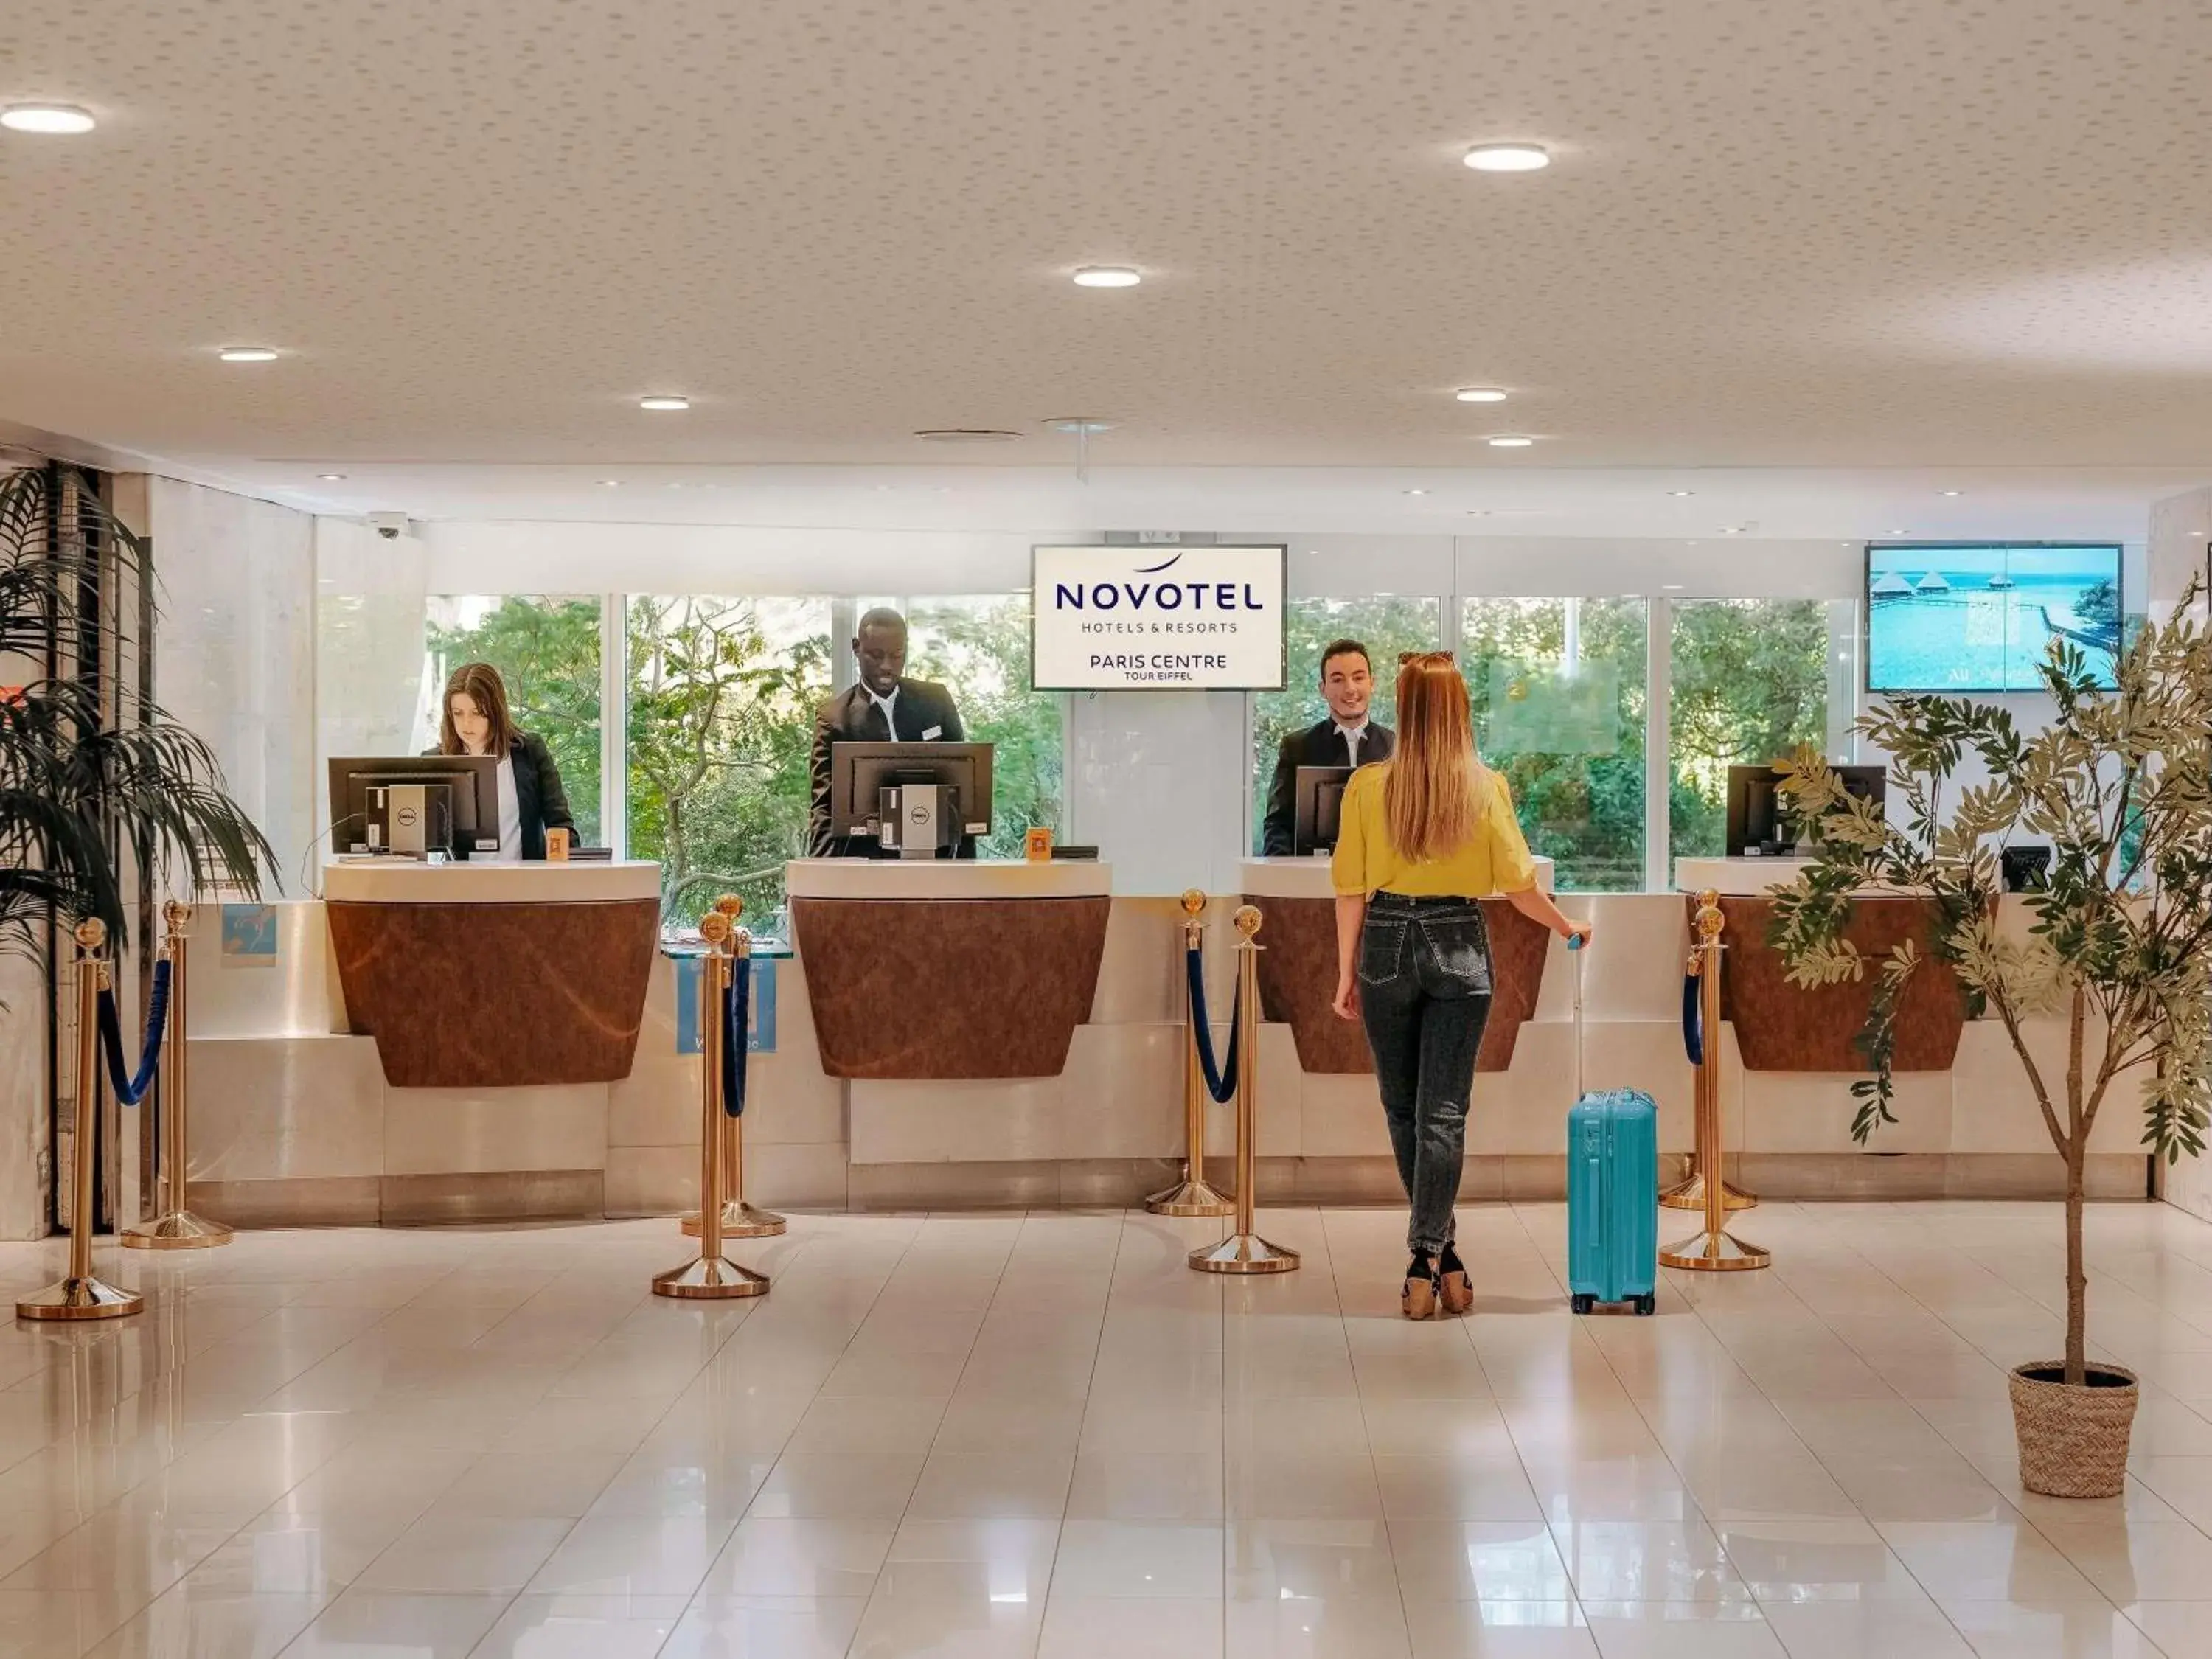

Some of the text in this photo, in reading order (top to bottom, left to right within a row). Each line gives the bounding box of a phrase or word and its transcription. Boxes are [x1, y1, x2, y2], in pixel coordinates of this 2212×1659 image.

[1057, 583, 1263, 611] NOVOTEL
[1082, 622, 1237, 633] HOTELS & RESORTS
[1091, 654, 1227, 669] PARIS CENTRE
[1125, 672, 1192, 681] TOUR EIFFEL
